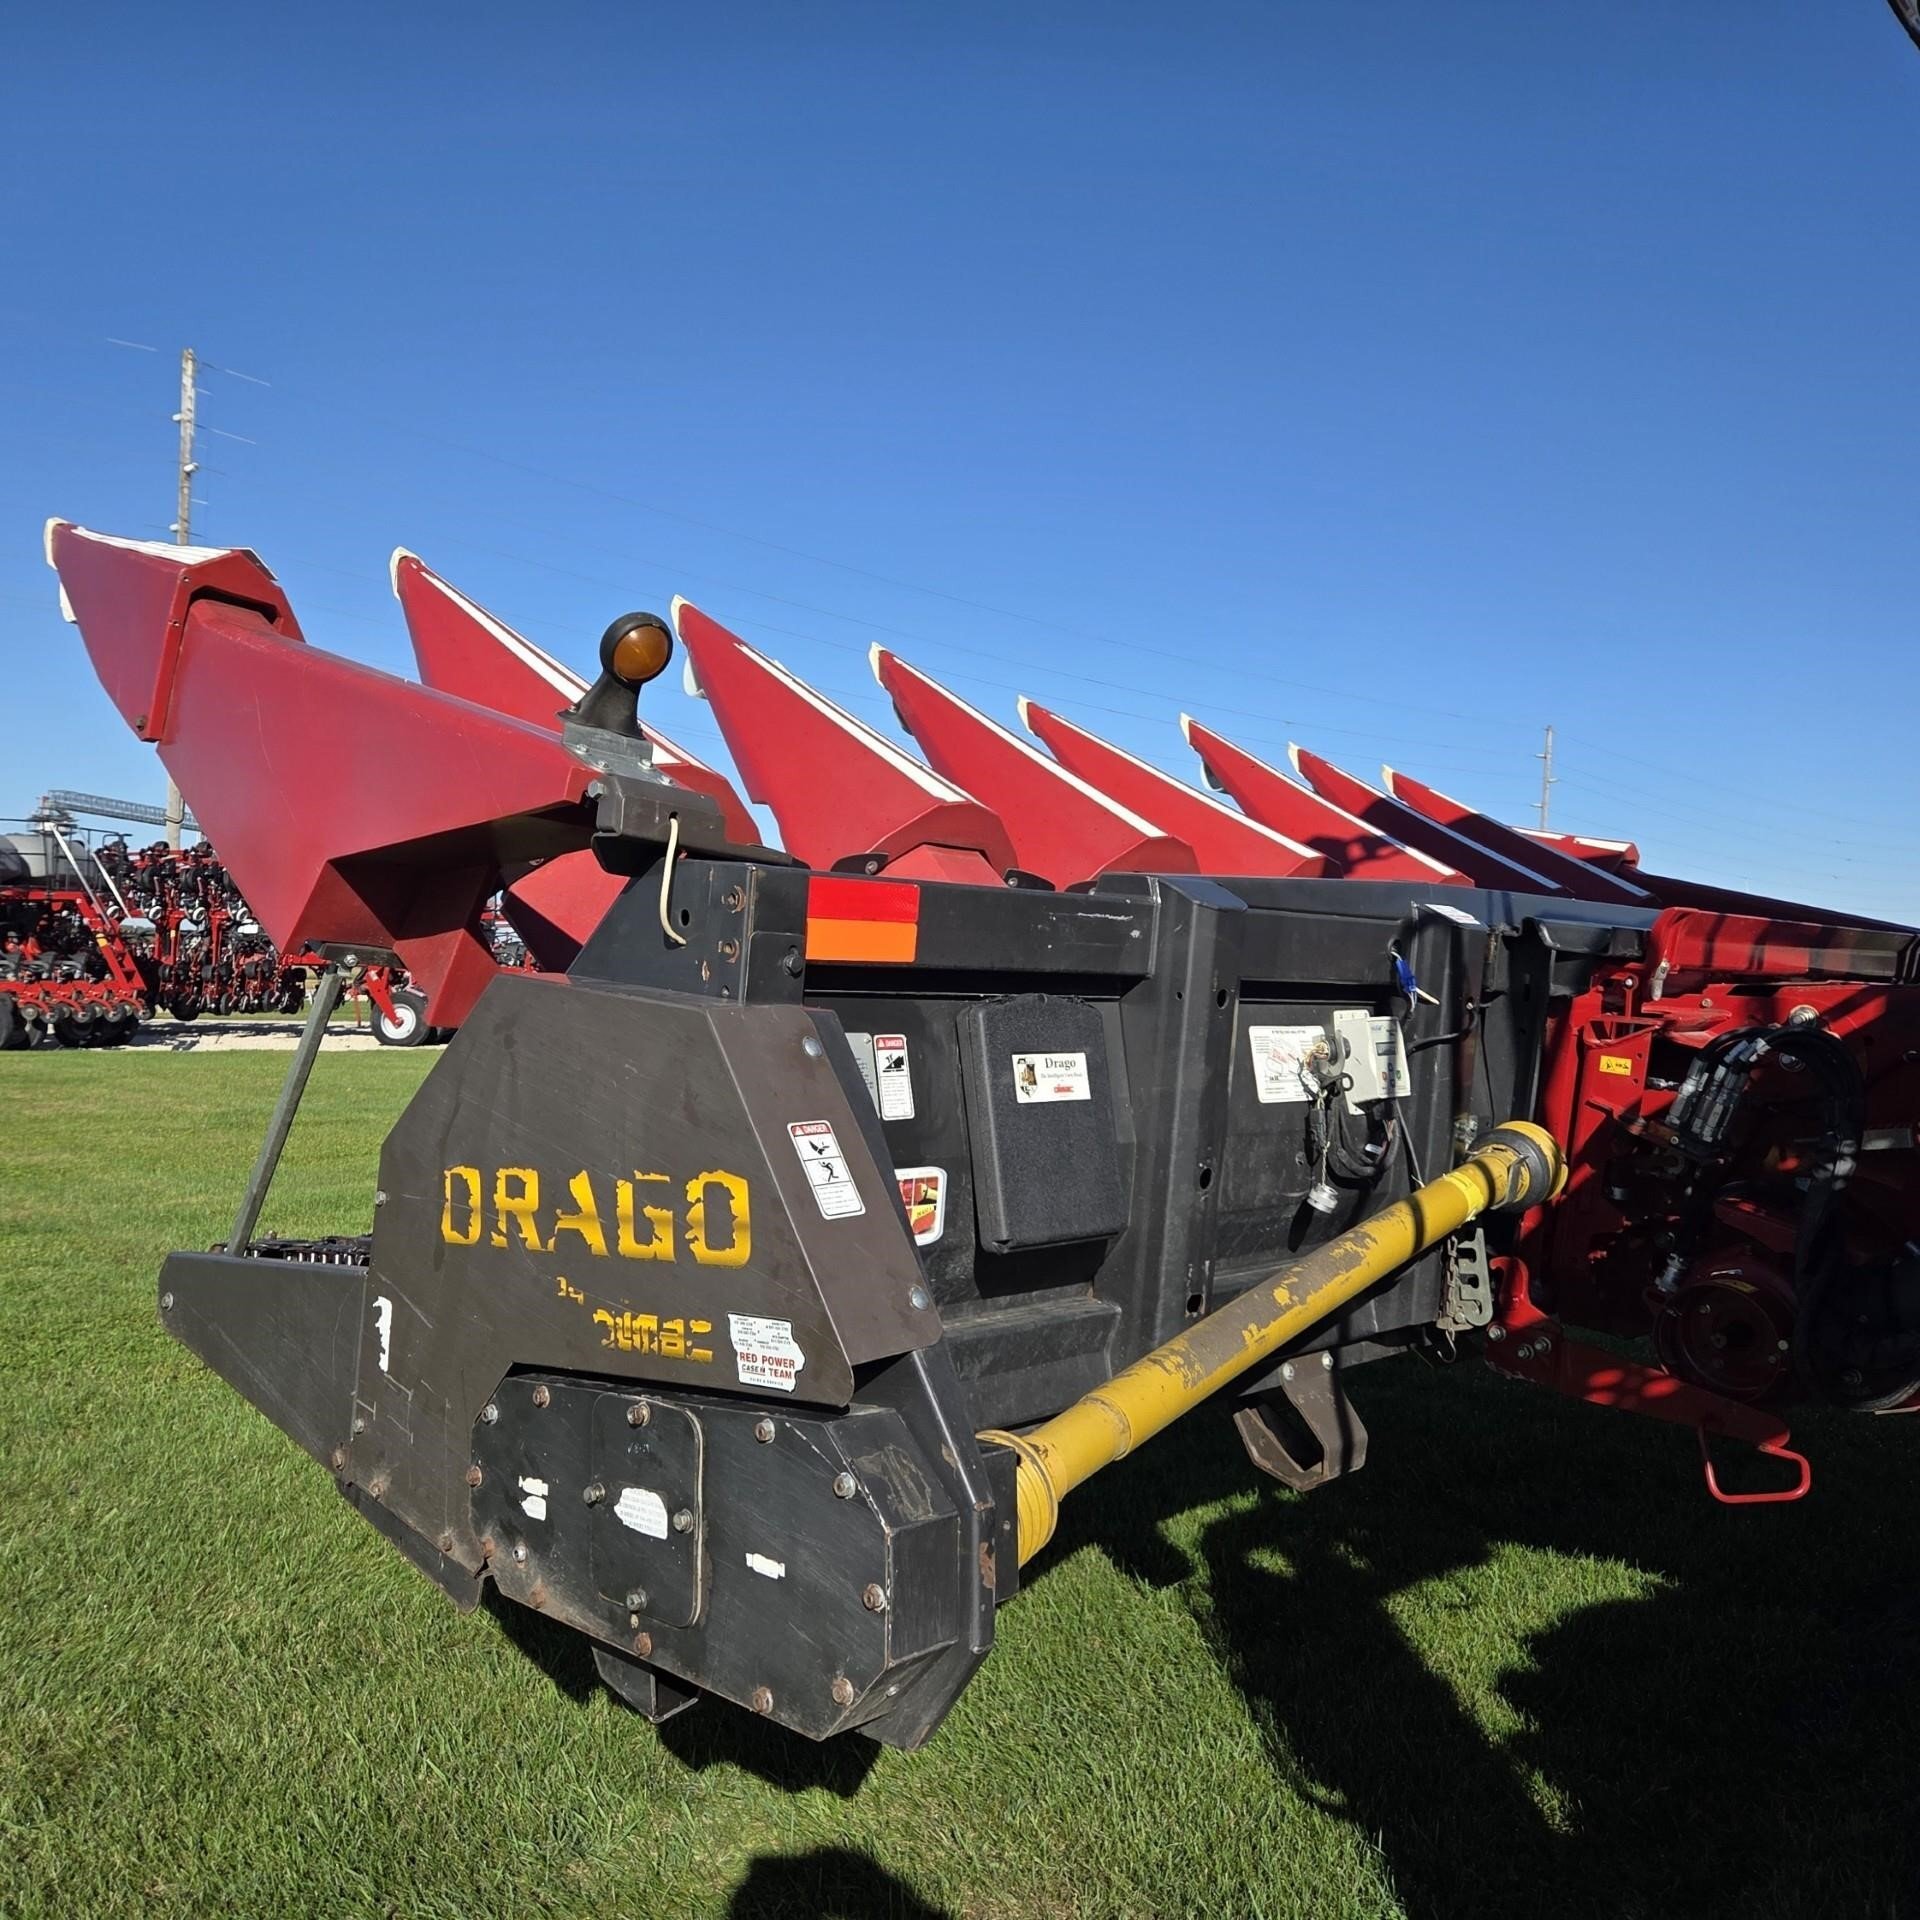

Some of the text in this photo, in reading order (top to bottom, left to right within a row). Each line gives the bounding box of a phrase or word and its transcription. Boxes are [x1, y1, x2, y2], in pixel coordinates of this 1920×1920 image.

[1045, 1057, 1076, 1070] Drago
[441, 1164, 751, 1267] DRAGO
[739, 1352, 795, 1369] RED POWER
[741, 1364, 759, 1373] CASE
[769, 1367, 792, 1380] TEAM
